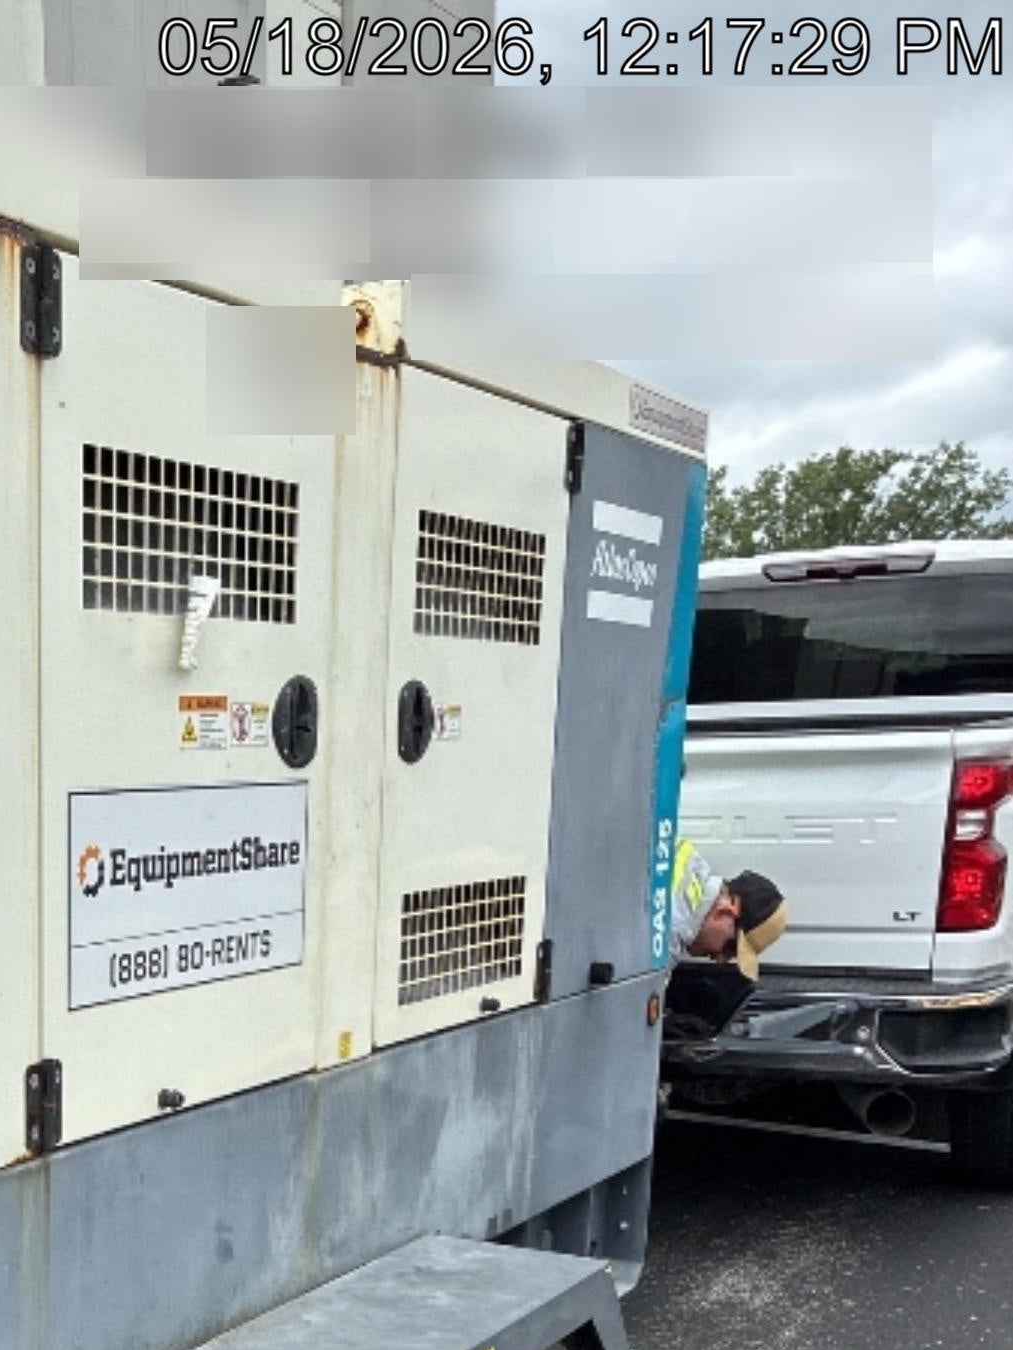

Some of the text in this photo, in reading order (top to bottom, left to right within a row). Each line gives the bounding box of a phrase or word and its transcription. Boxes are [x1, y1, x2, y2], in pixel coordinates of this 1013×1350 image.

[109, 837, 301, 892] EquipmentShare
[655, 818, 673, 877] 125
[892, 911, 922, 922] LT
[109, 943, 169, 989] (888)
